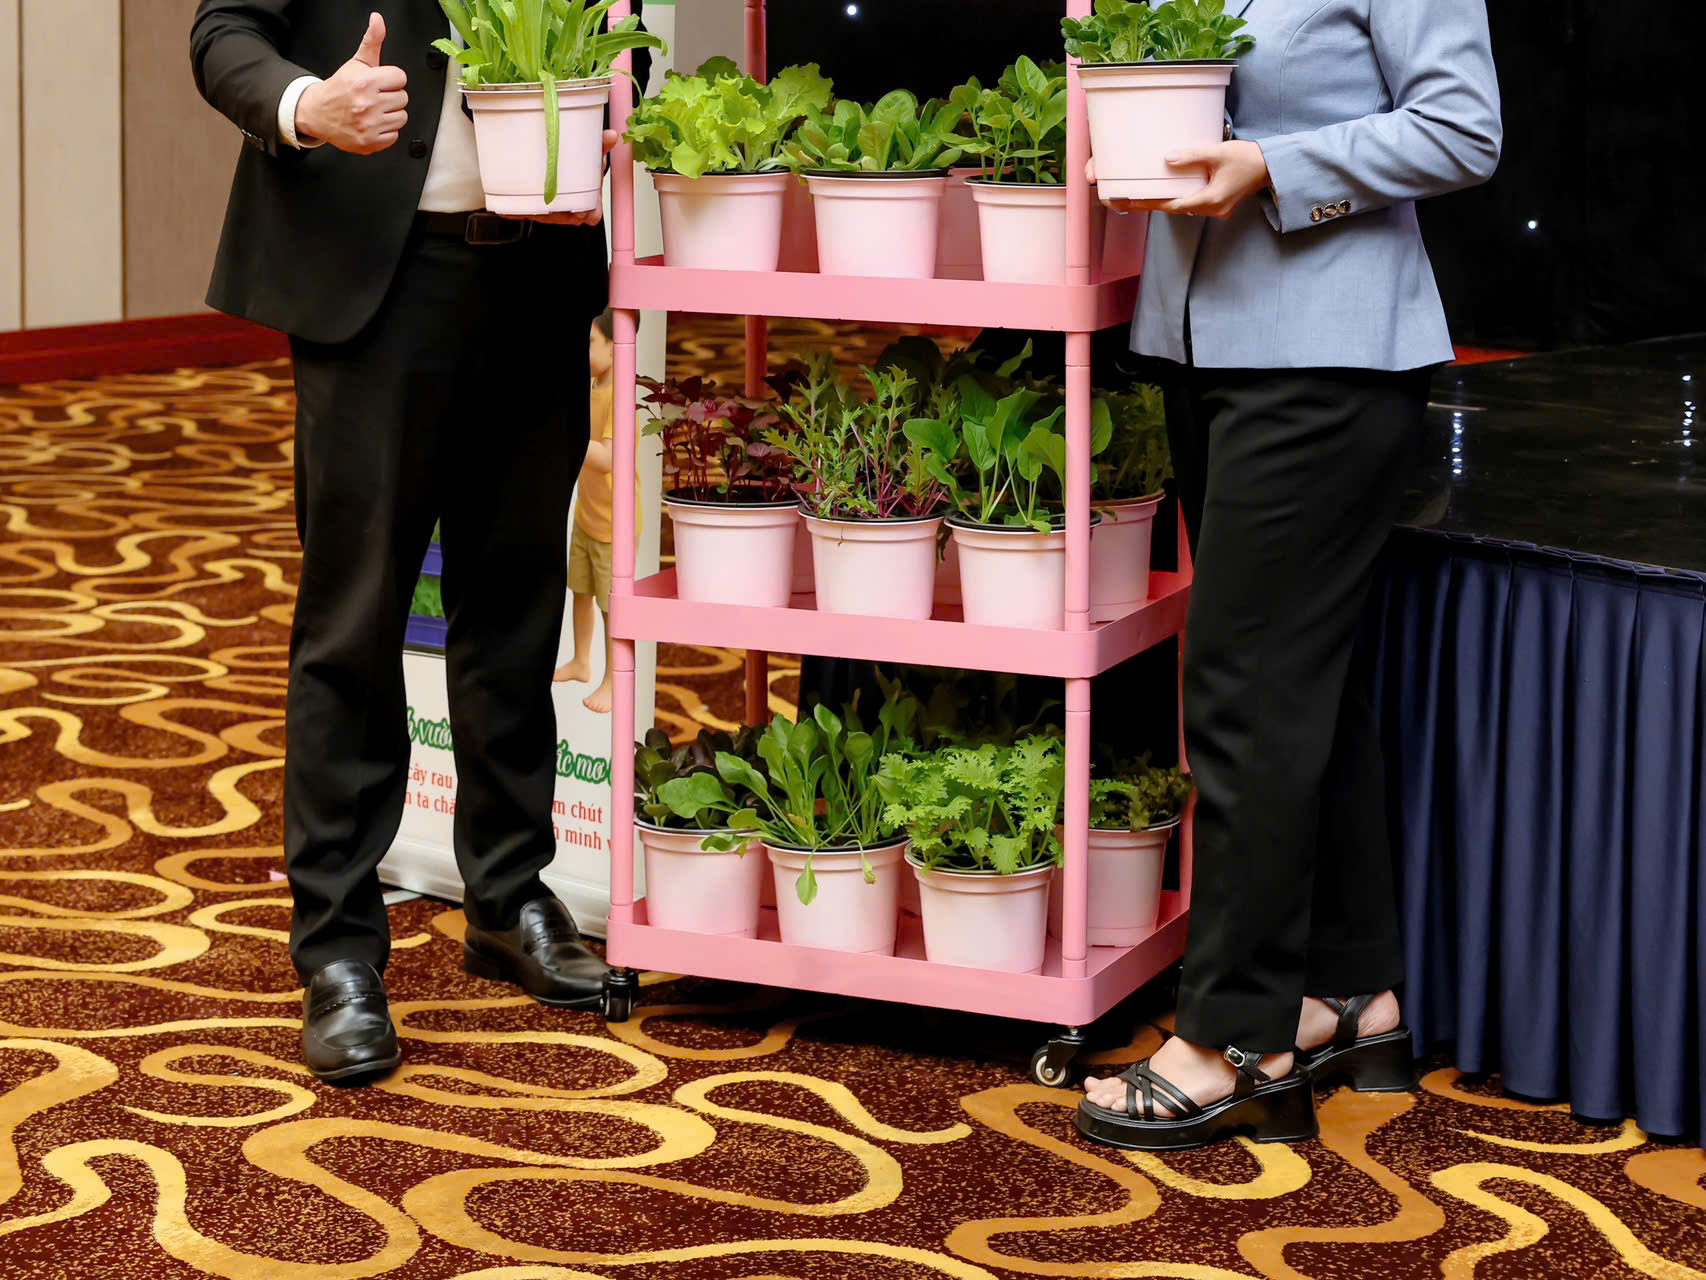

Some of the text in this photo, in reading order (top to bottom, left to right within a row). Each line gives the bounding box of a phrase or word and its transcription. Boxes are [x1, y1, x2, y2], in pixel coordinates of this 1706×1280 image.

[417, 791, 430, 809] ta
[431, 772, 453, 790] rau
[571, 801, 602, 824] chút
